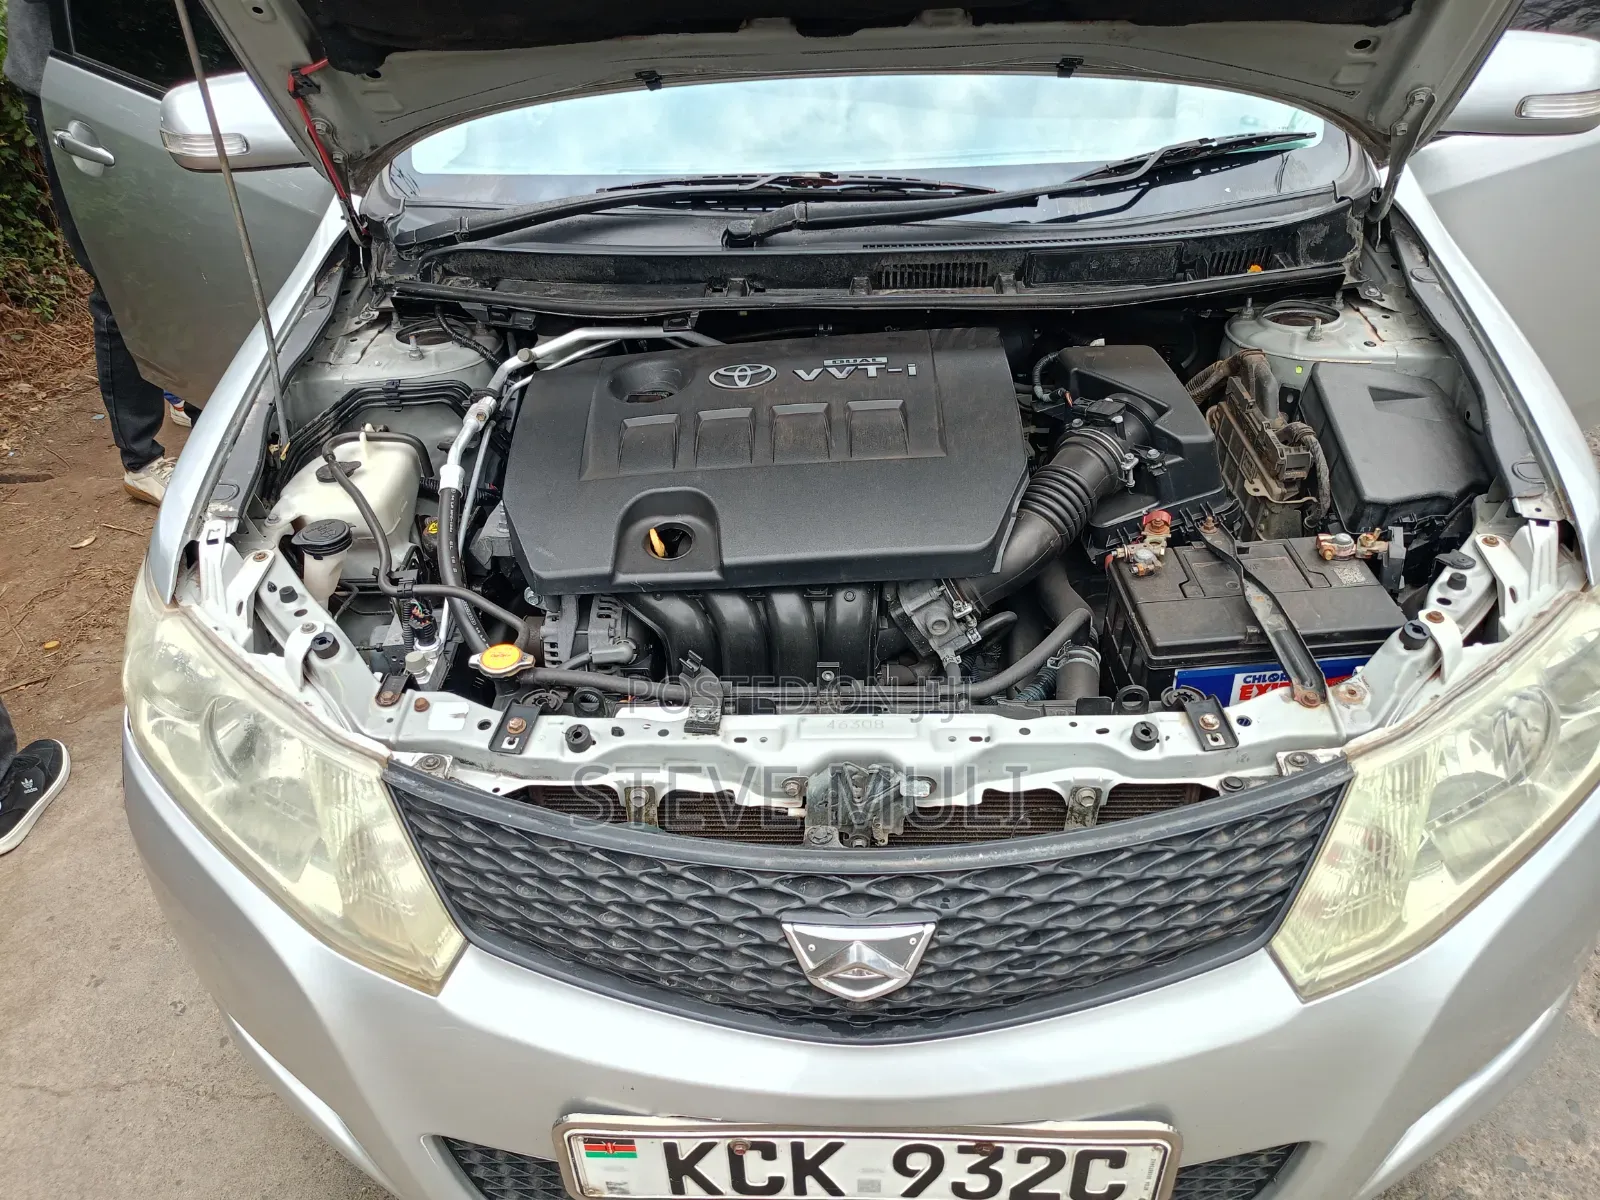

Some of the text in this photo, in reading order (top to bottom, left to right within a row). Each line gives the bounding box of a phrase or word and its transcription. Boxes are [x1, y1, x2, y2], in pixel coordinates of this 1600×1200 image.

[793, 363, 917, 381] VVT-i
[662, 1141, 846, 1197] KCK
[893, 1143, 1129, 1200] 932C
